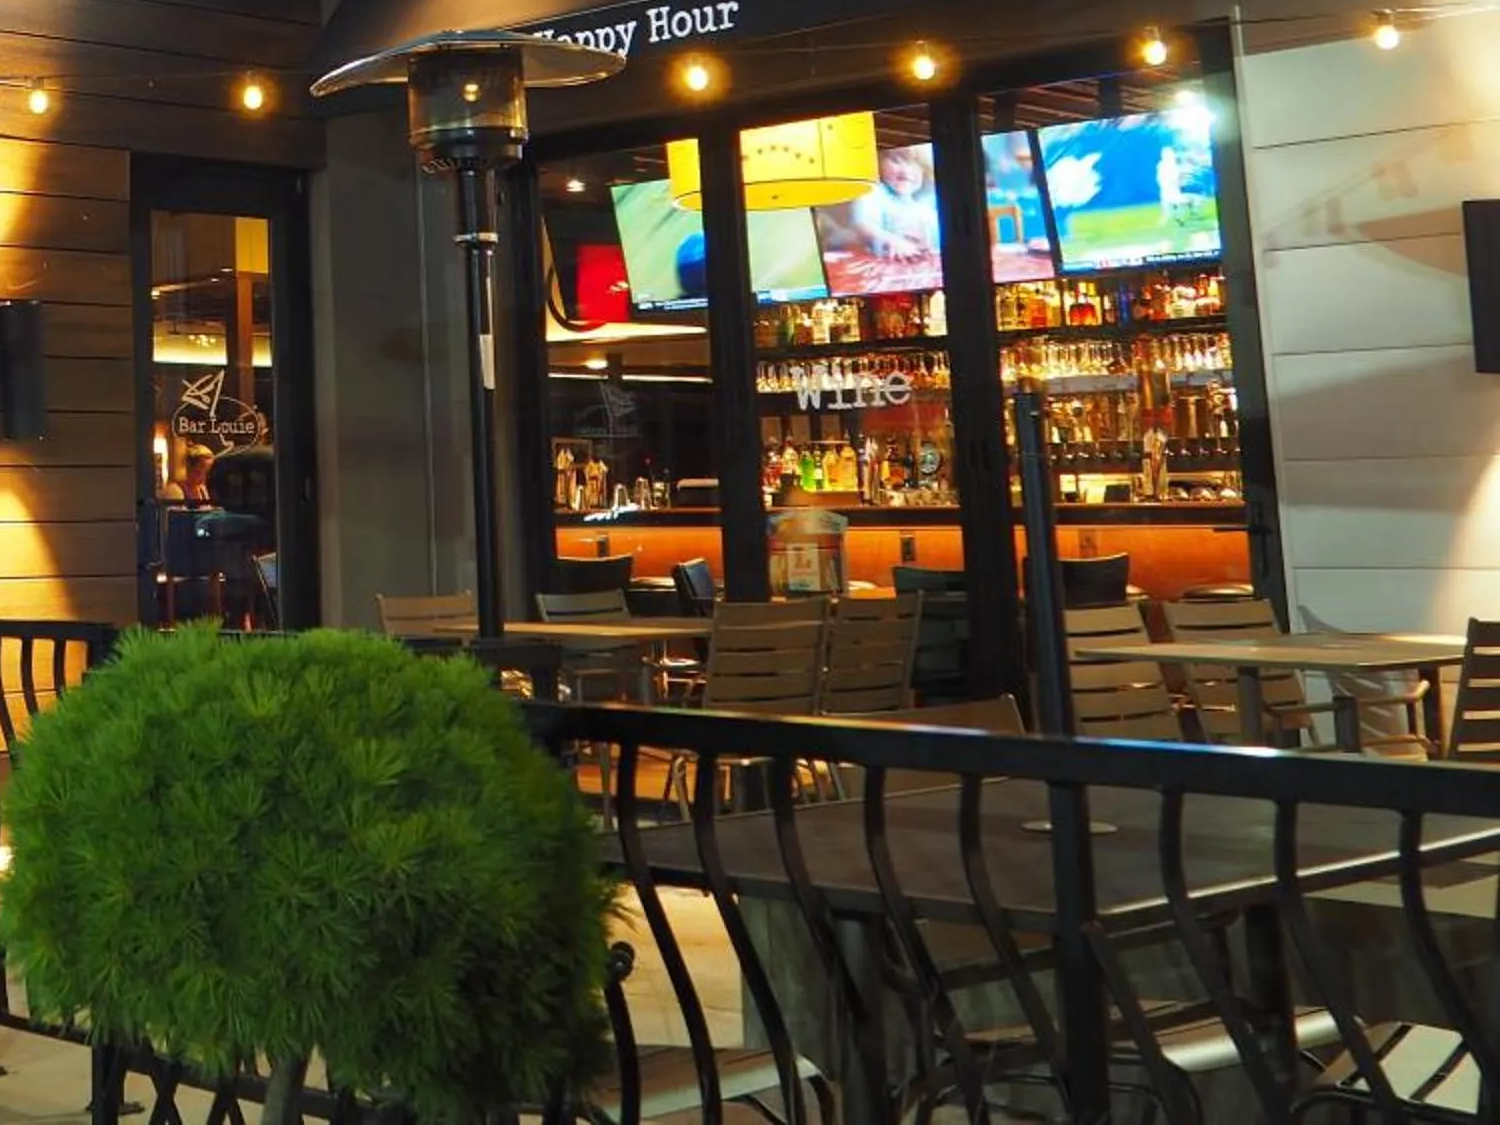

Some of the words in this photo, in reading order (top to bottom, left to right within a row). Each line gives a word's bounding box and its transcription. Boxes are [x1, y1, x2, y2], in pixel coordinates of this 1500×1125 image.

[645, 0, 740, 43] Hour
[789, 365, 912, 410] Wine
[178, 415, 207, 434] Bar
[209, 418, 255, 434] Louie
